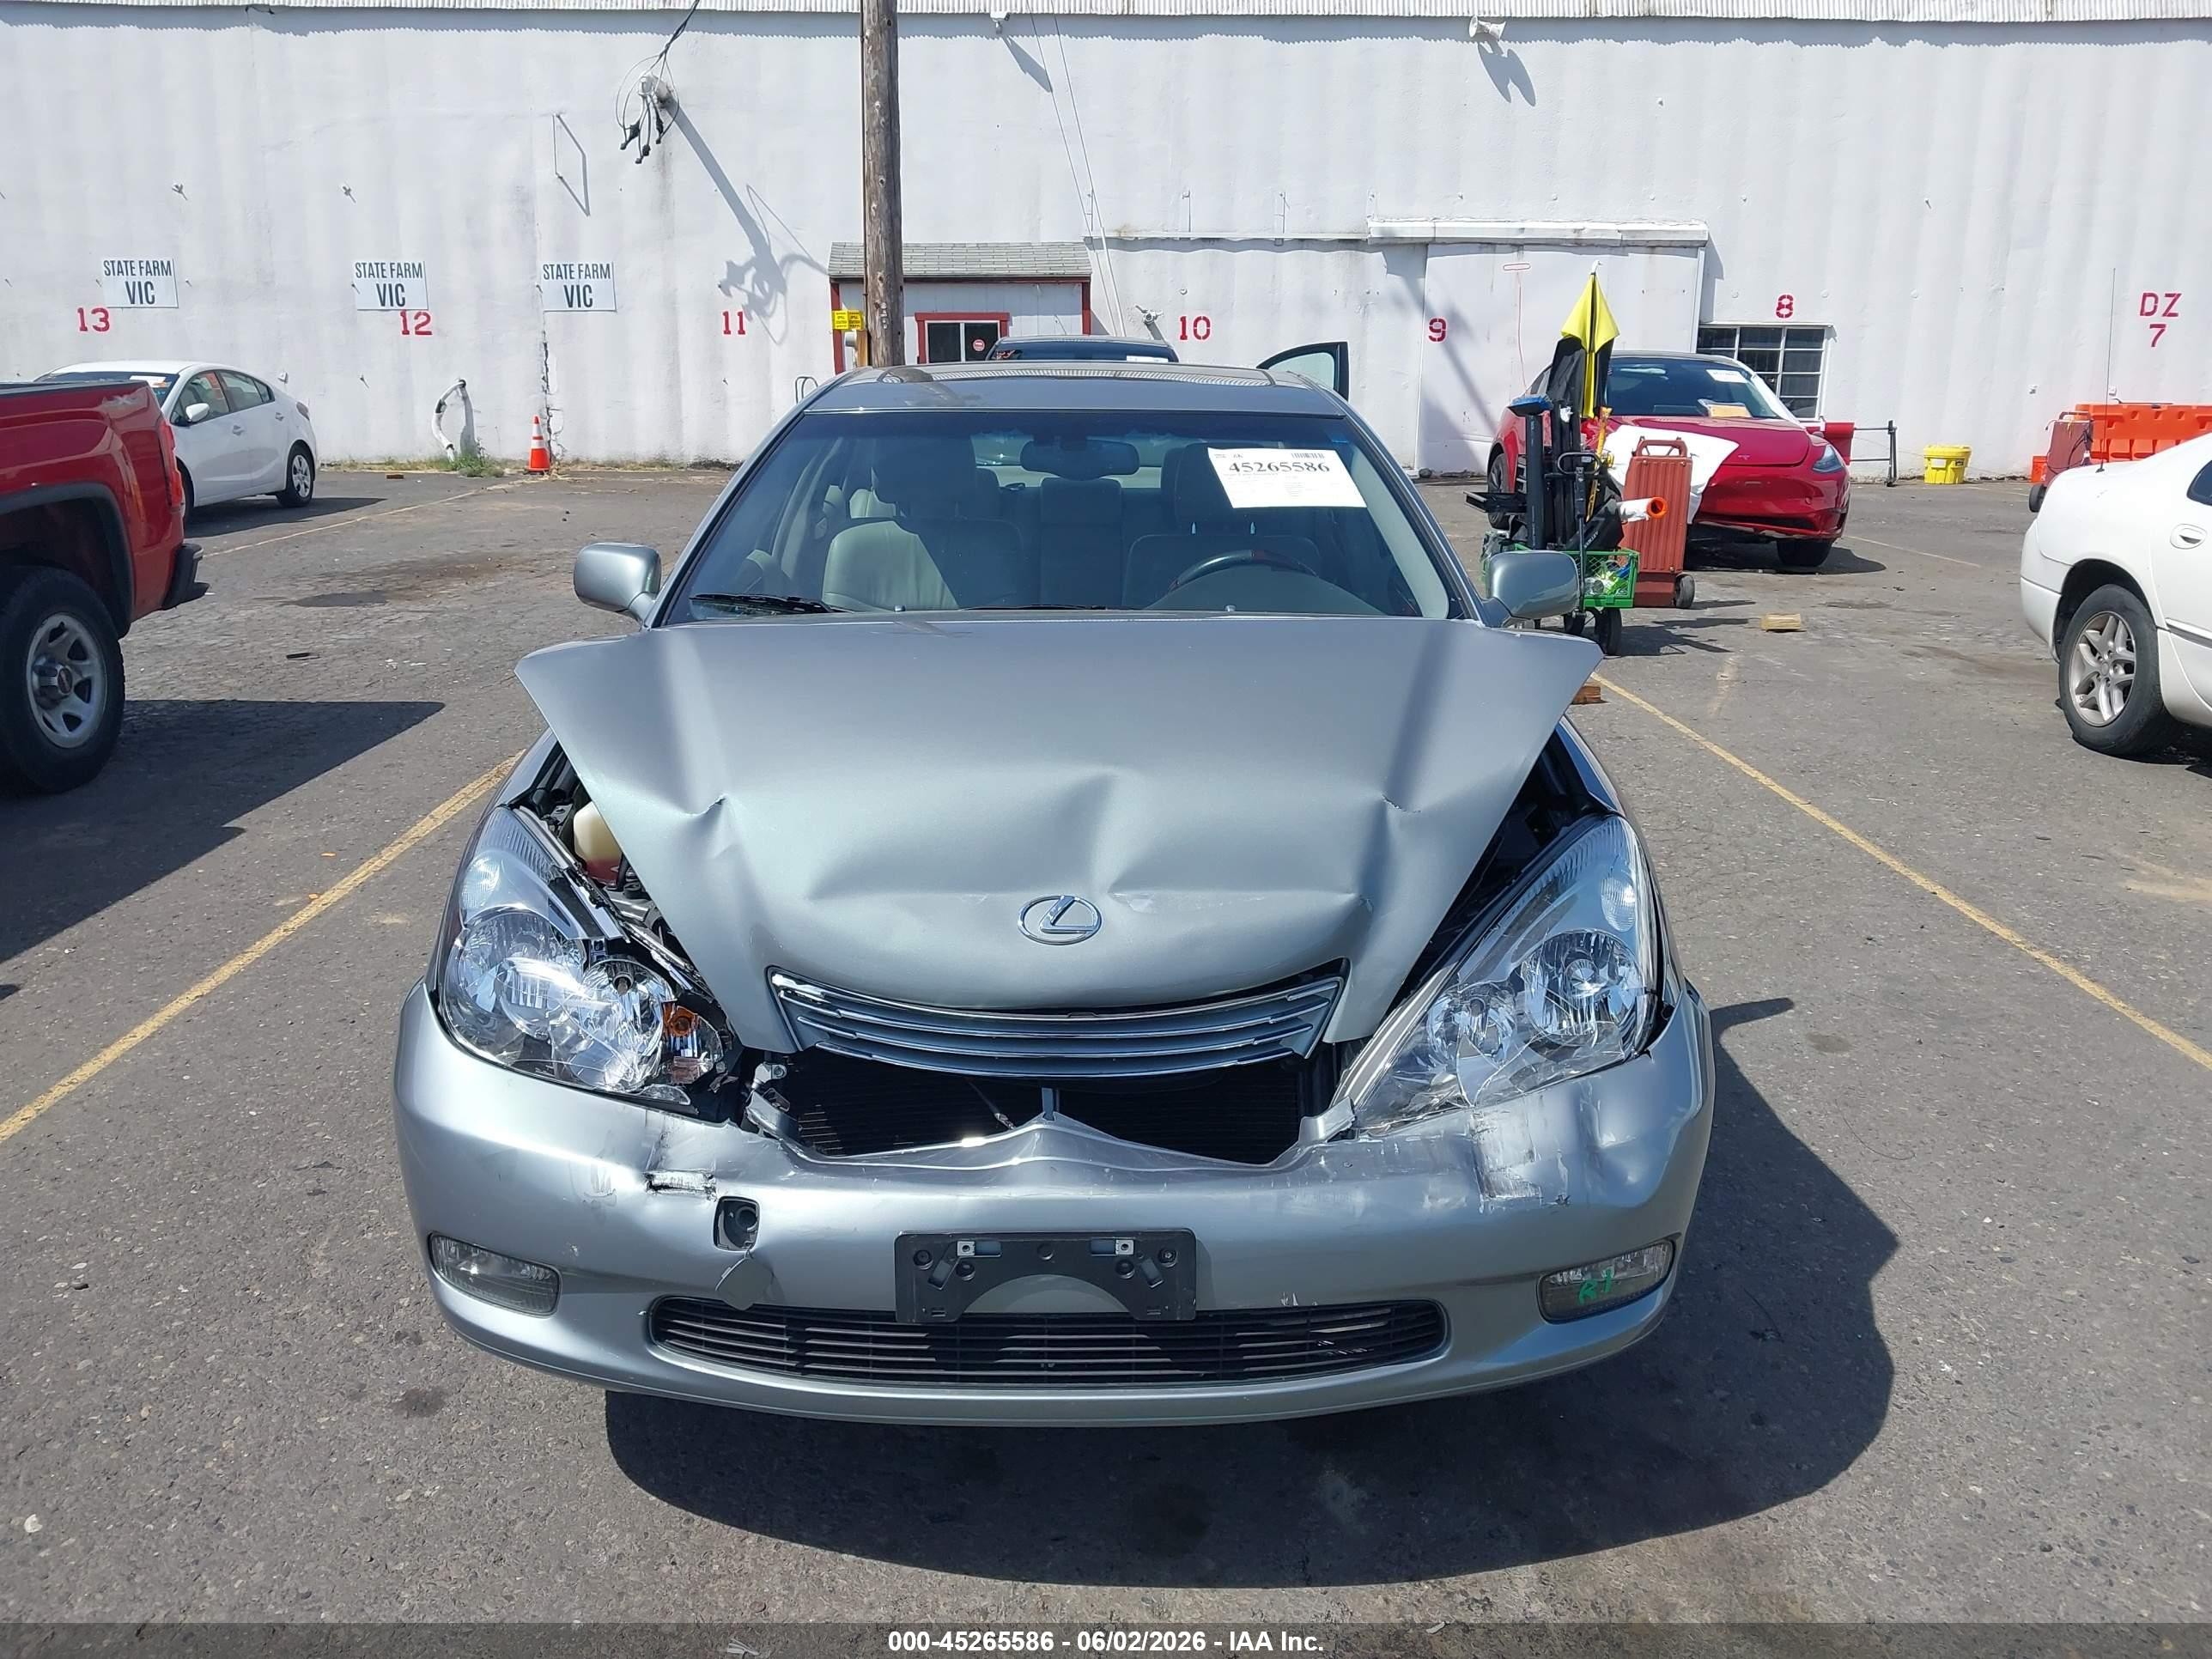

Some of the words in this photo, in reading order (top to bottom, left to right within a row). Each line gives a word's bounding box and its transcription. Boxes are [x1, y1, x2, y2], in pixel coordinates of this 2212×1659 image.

[103, 259, 137, 276] STATE
[138, 259, 173, 276] FARM
[355, 262, 387, 278] STATE
[389, 262, 423, 278] FARM
[543, 264, 574, 280] STATE
[578, 263, 611, 279] FARM
[125, 281, 155, 305] VIC
[376, 283, 405, 307] VIC
[563, 284, 593, 308] VIC
[2139, 292, 2182, 318] DZ
[1776, 294, 1794, 319] 8
[77, 307, 110, 332] 13
[400, 309, 433, 335] 12
[722, 310, 745, 335] 11
[1179, 315, 1211, 340] 10
[1428, 318, 1447, 343] 9
[2149, 324, 2166, 348] 7
[1229, 461, 1330, 473] 45265586
